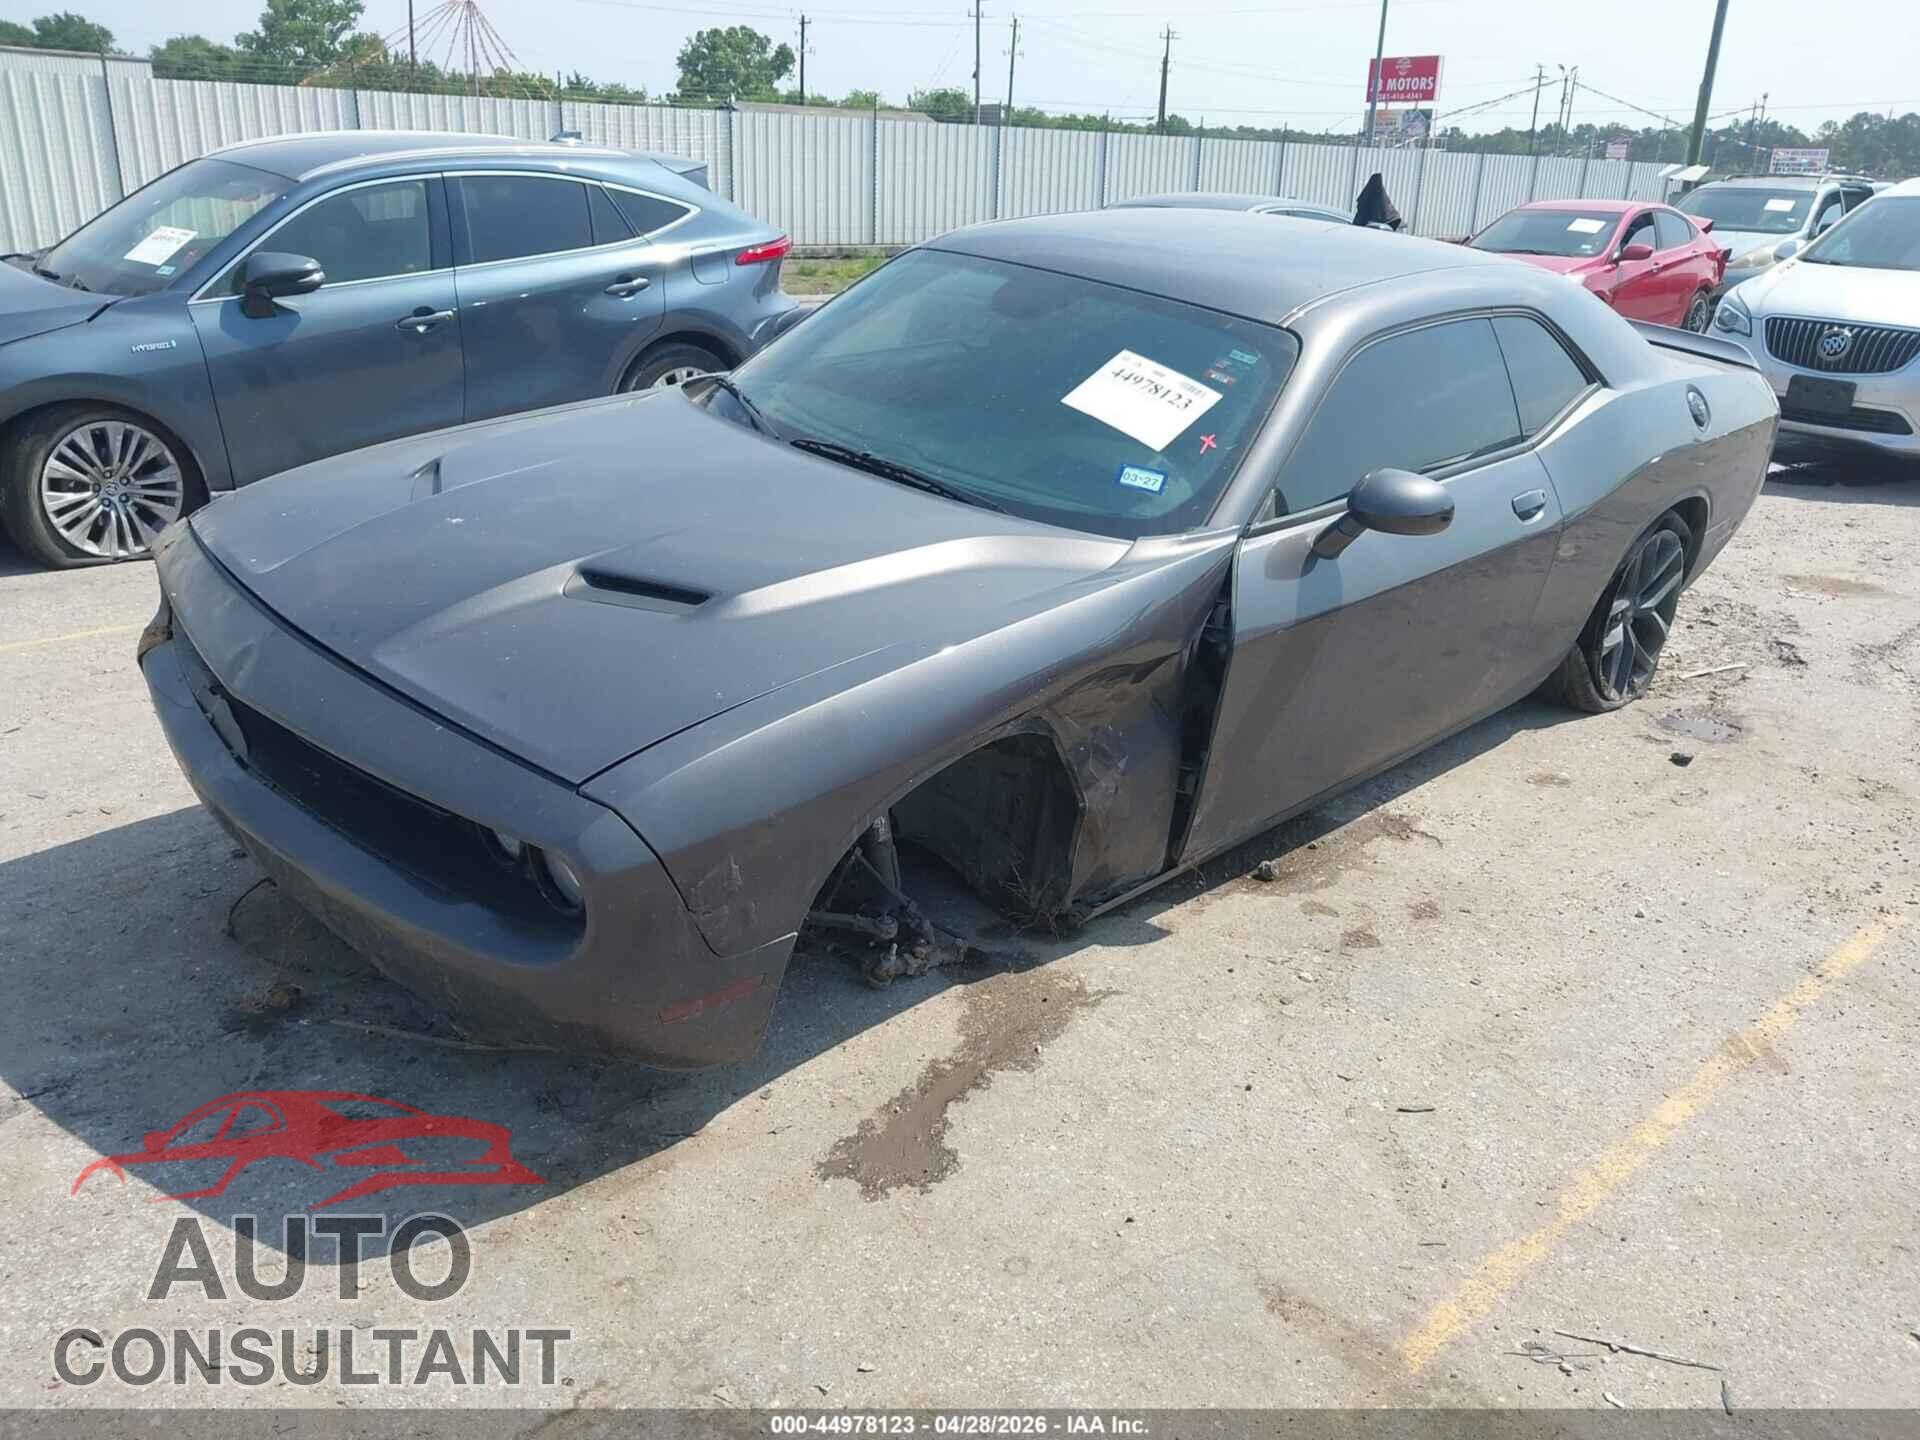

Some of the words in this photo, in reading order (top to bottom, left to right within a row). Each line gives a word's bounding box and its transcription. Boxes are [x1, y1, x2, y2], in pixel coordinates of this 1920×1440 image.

[1386, 76, 1434, 91] MOTORS
[131, 341, 171, 353] HYBRID
[1111, 368, 1193, 411] 44978123
